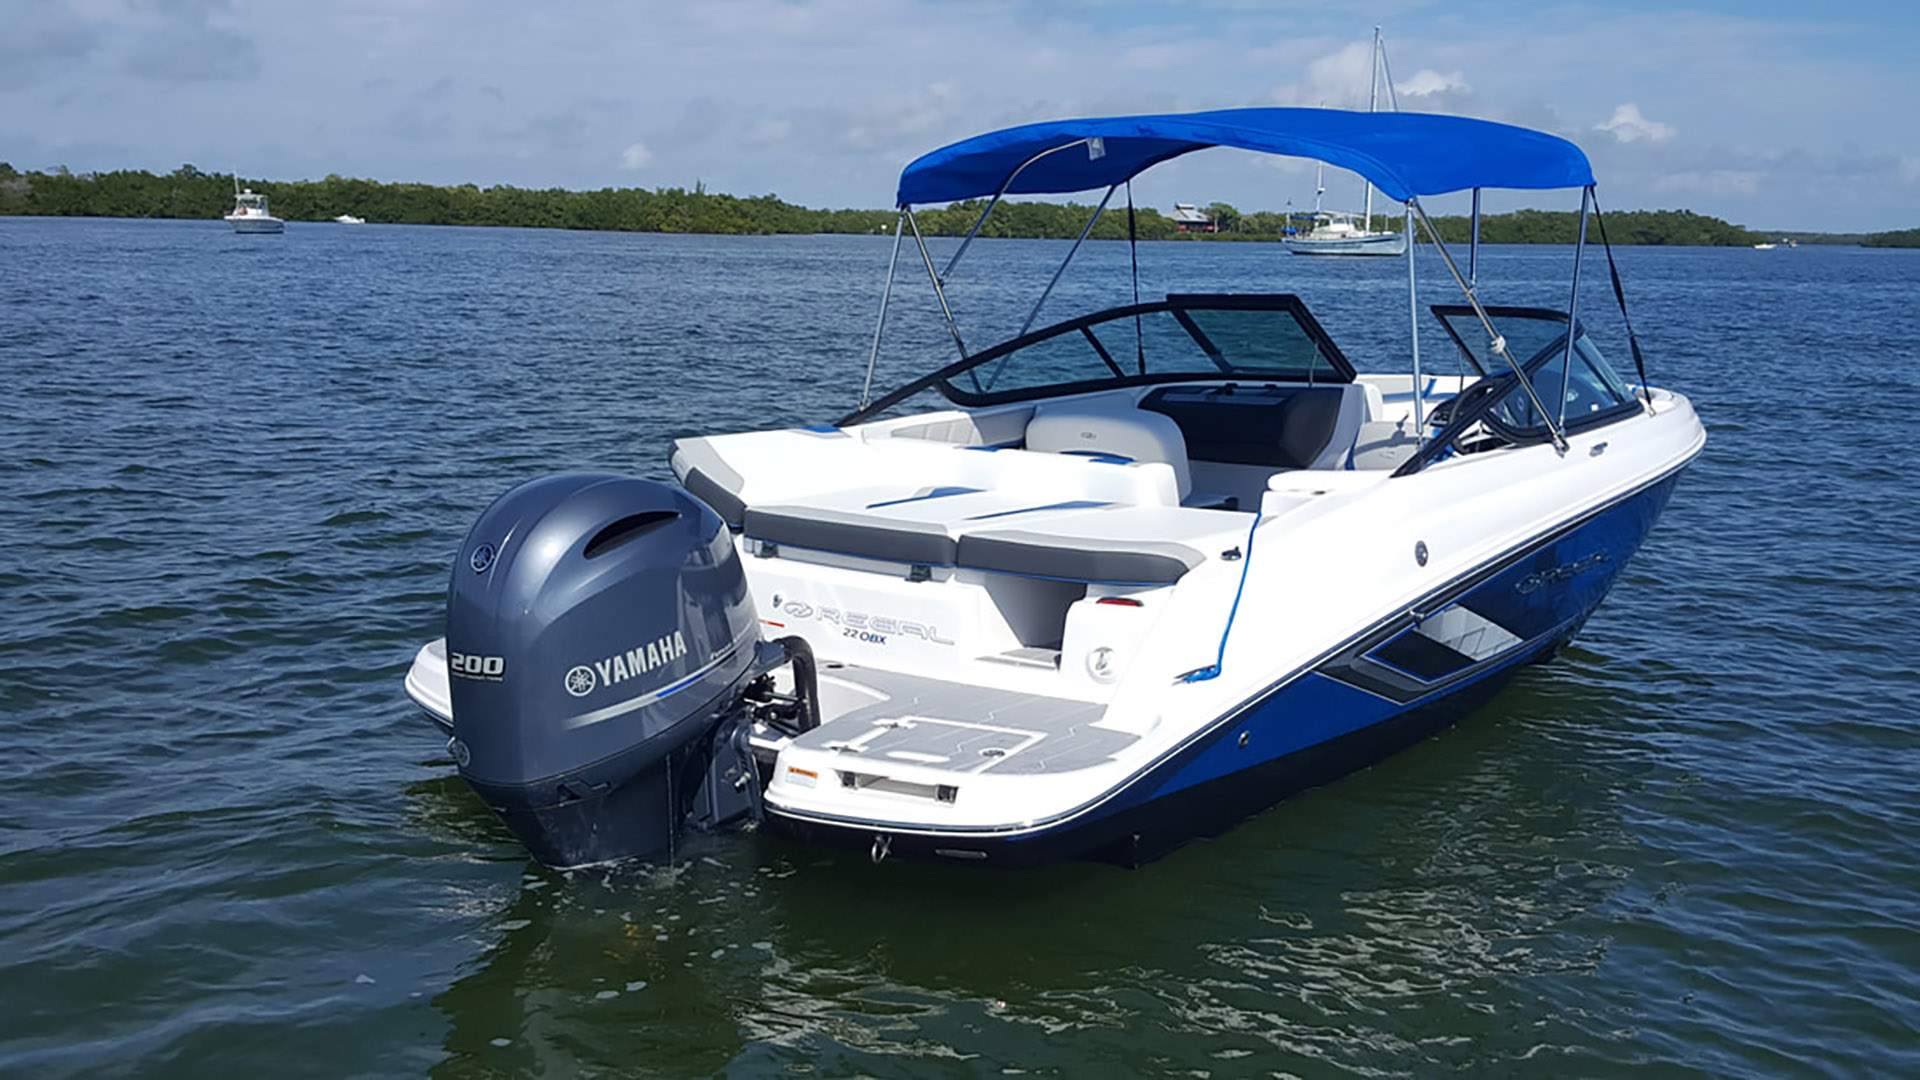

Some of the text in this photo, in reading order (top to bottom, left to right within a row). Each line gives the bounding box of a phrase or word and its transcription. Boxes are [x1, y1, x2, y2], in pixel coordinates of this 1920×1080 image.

[816, 606, 955, 646] REGAL
[842, 627, 887, 646] 22 OBX
[451, 652, 504, 675] 200
[594, 630, 687, 687] YAMAHA
